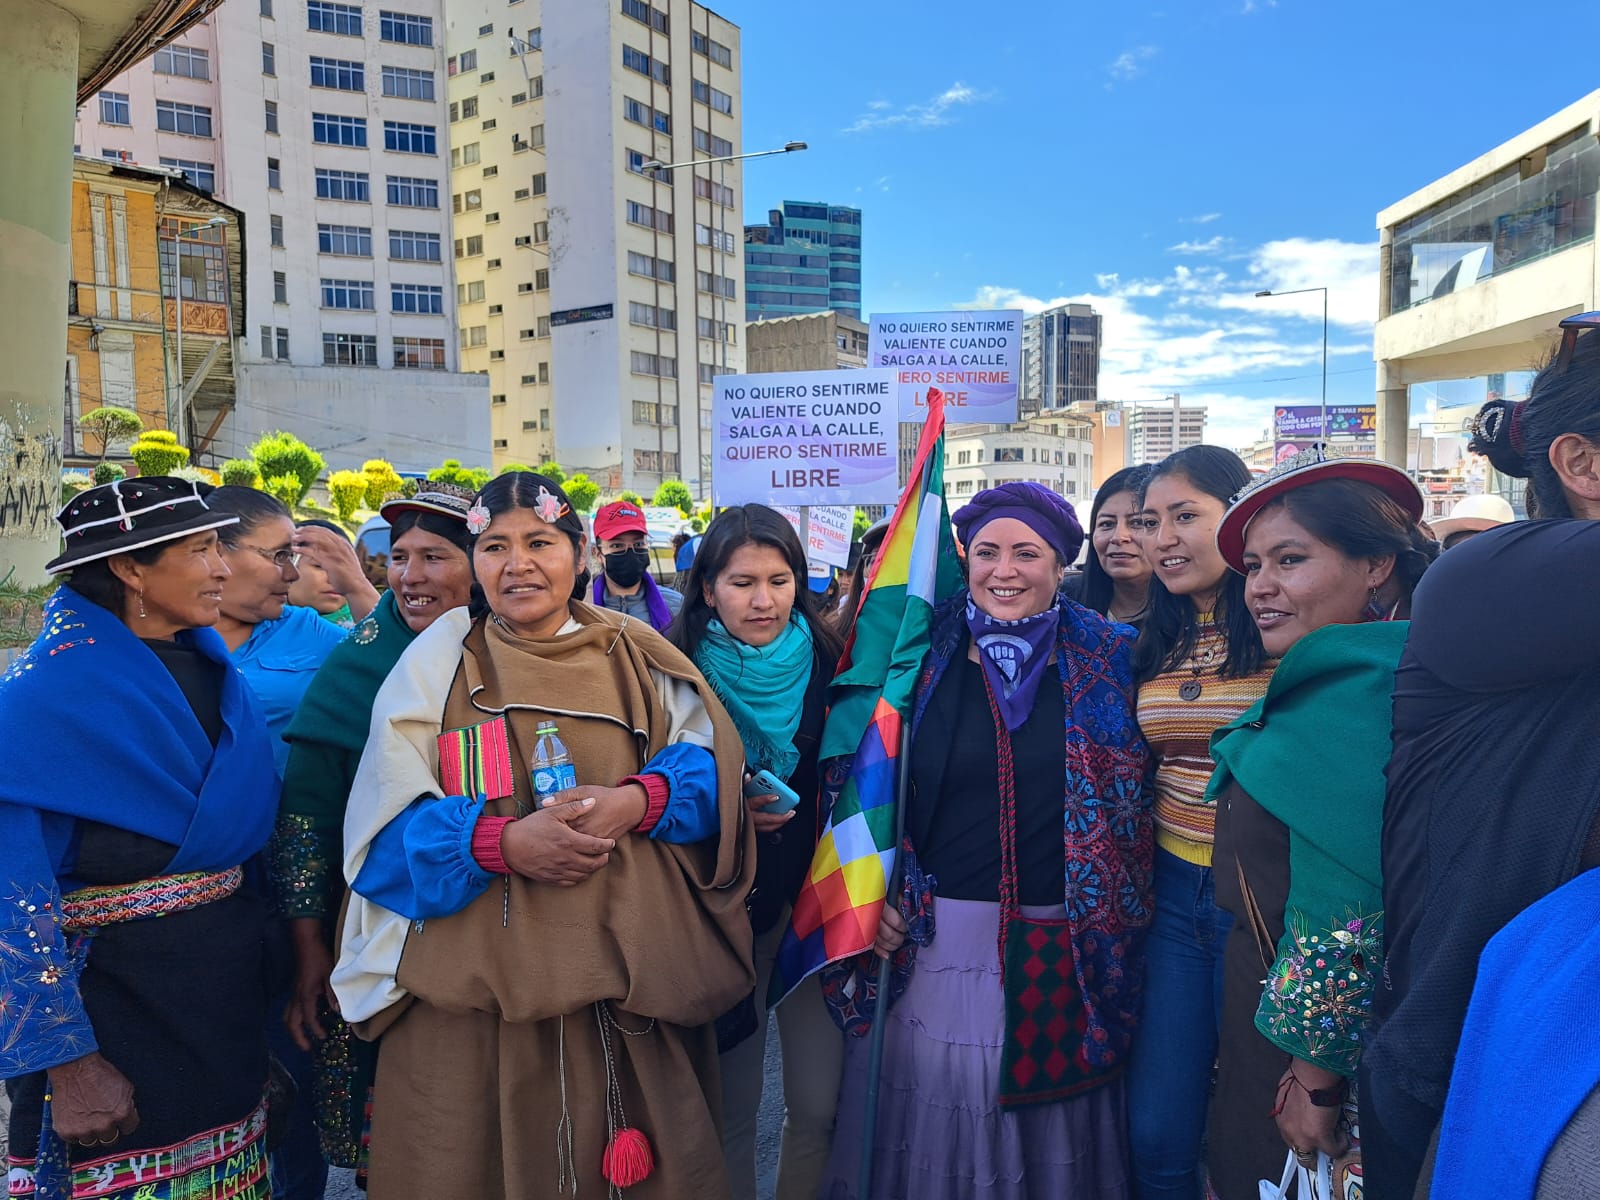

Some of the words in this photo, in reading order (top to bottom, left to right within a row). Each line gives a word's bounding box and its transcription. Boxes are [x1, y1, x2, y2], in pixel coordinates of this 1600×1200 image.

[879, 323, 896, 333] NO
[900, 322, 947, 333] QUIERO
[951, 321, 1015, 332] SENTIRME
[884, 338, 946, 350] VALIENTE
[950, 337, 1007, 349] CUANDO
[881, 355, 924, 366] SALGA
[927, 355, 937, 365] A
[940, 355, 957, 365] LA
[960, 354, 1008, 367] CALLE,
[898, 371, 932, 383] IERO
[936, 371, 1010, 383] SENTIRME
[724, 388, 745, 400] NO
[750, 385, 807, 400] QUIERO
[811, 382, 889, 397] SENTIRME
[914, 391, 969, 406] LRE
[731, 405, 806, 419] VALIENTE
[811, 401, 881, 417] CUANDO
[729, 425, 783, 439] SALGA
[786, 424, 798, 438] A
[802, 423, 822, 437] LA
[826, 422, 884, 438] CALLE,
[726, 446, 793, 460] QUIERO
[798, 442, 887, 458] SENTIRME
[771, 468, 841, 488] LIBRE
[809, 512, 820, 521] LA
[815, 505, 848, 520] CUANDO
